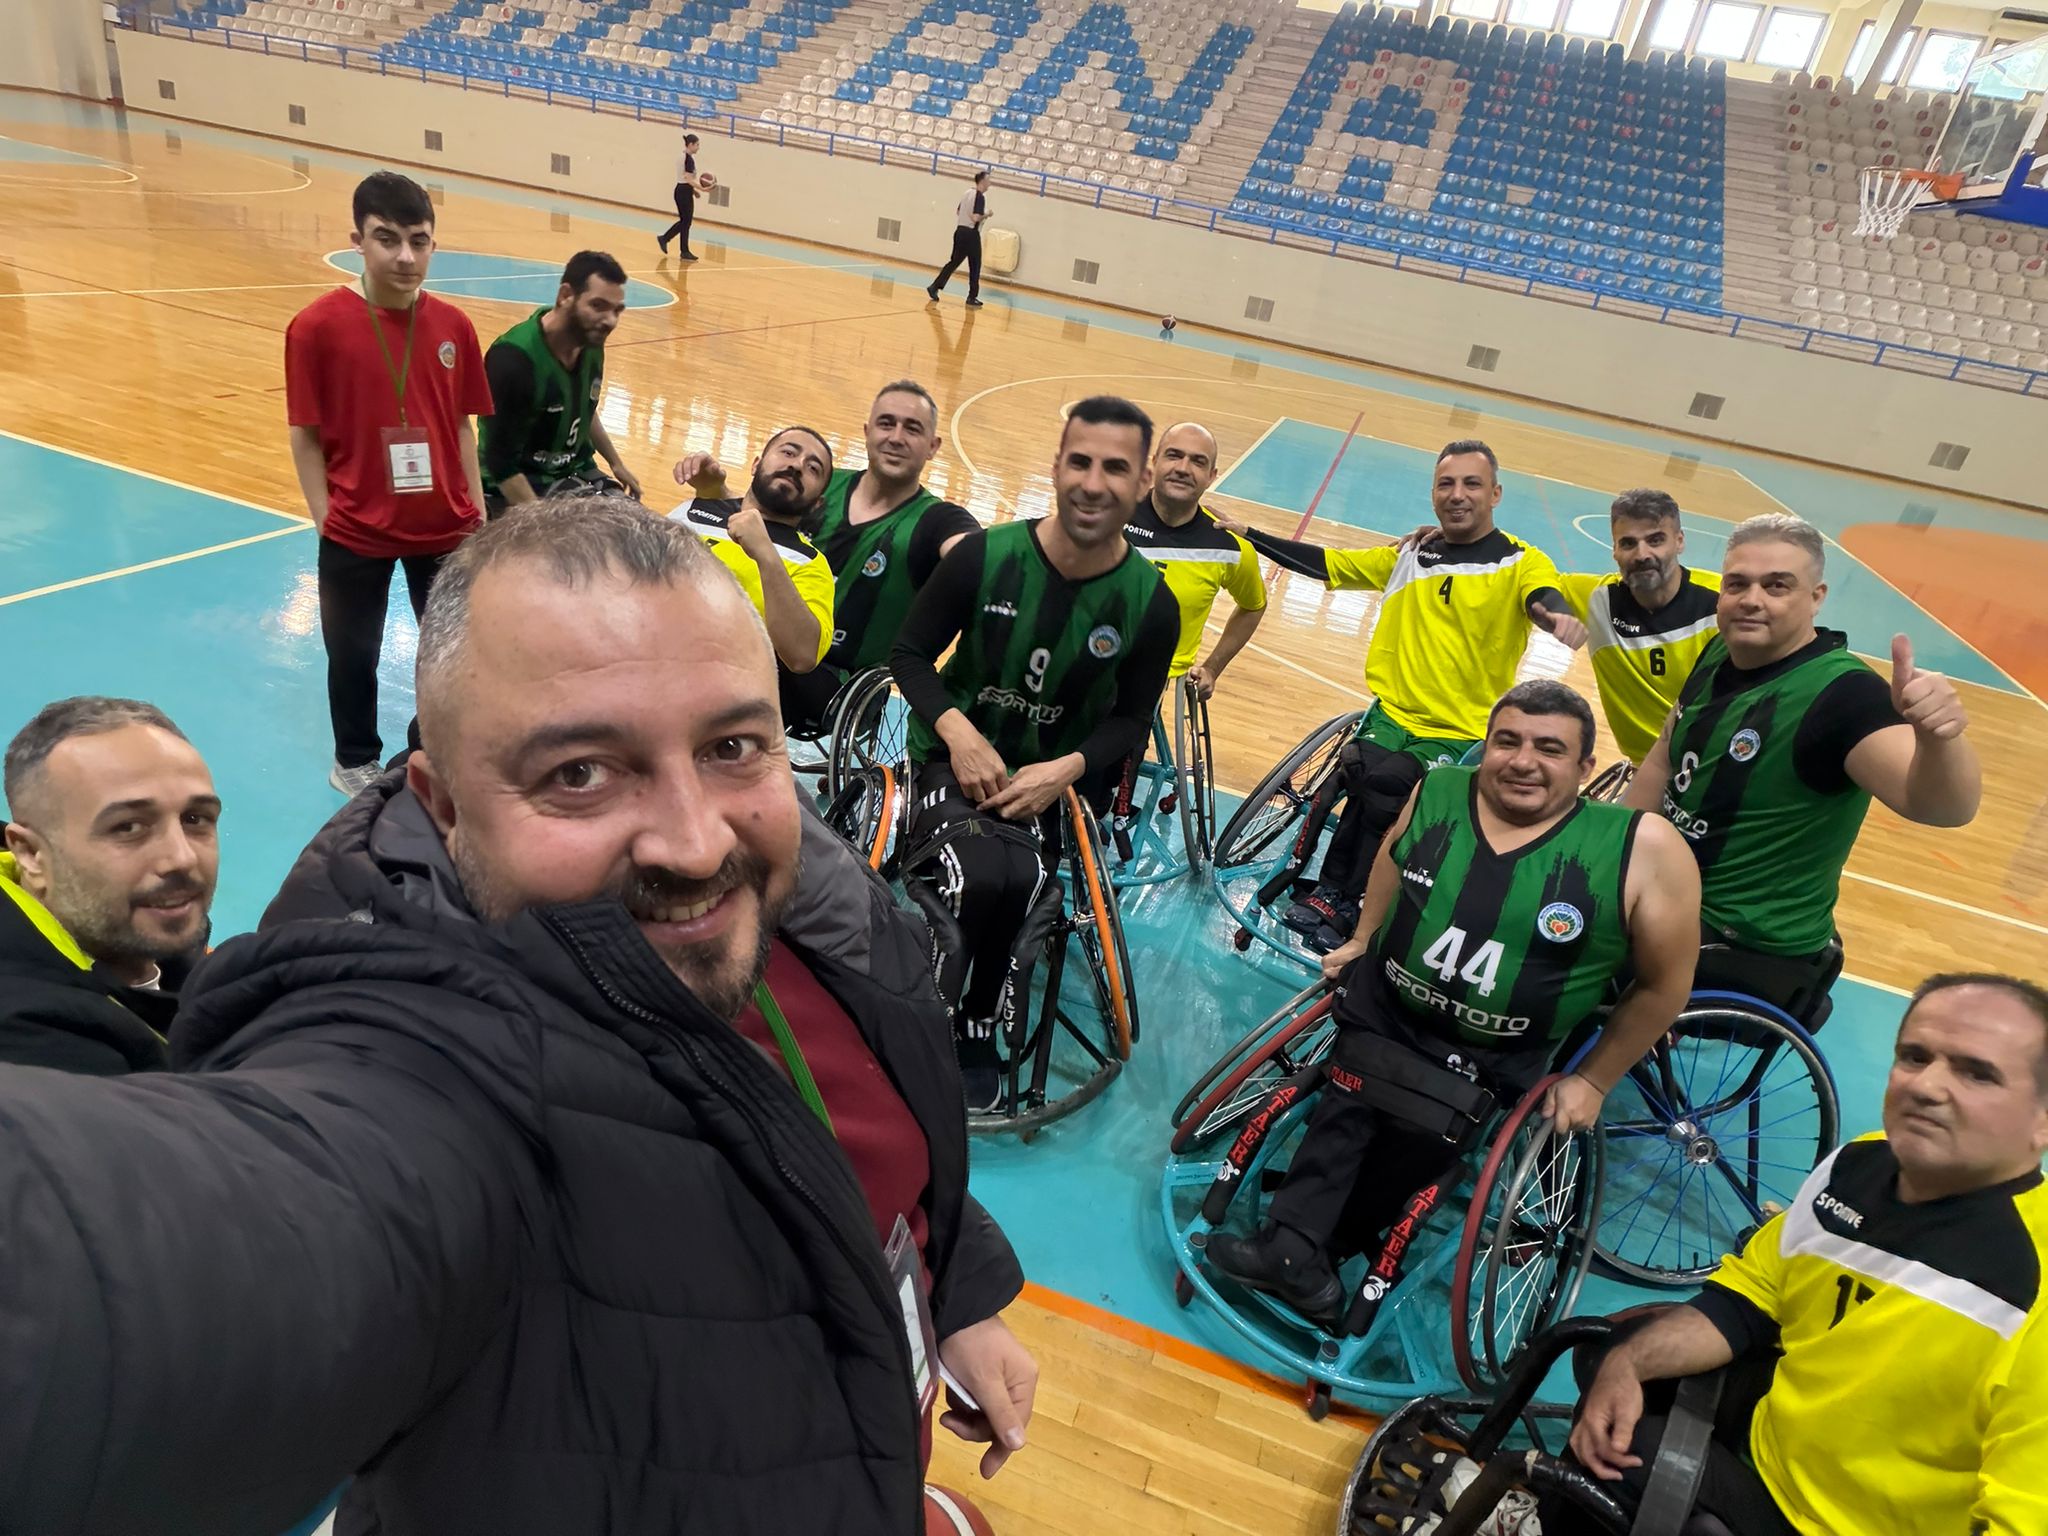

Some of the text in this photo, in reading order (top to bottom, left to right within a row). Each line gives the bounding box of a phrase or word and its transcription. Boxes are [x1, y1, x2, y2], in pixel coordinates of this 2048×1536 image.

[566, 417, 581, 447] 5
[1123, 523, 1155, 539] PORTIVE
[1438, 575, 1454, 605] 4
[1024, 647, 1052, 693] 9
[1649, 647, 1667, 677] 6
[1422, 925, 1506, 998] 44
[1385, 956, 1531, 1035] SPORTOTO
[1229, 1086, 1299, 1165] ATAER
[1375, 1184, 1439, 1278] ATAER
